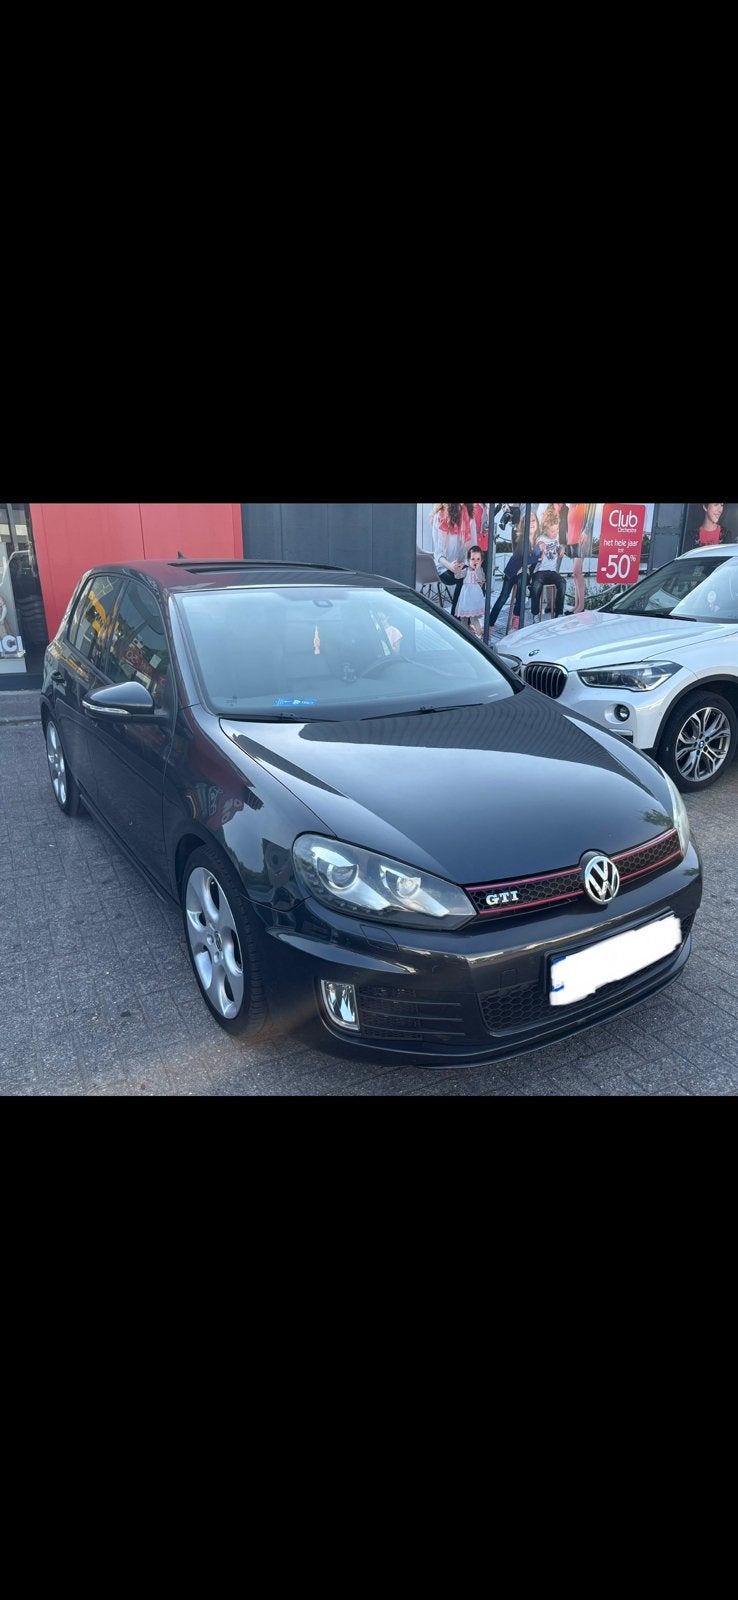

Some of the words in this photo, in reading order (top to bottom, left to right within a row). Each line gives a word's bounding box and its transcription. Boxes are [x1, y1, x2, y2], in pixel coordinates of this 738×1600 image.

[609, 510, 638, 527] Club
[627, 540, 638, 548] jaar
[601, 554, 636, 578] -50%
[486, 890, 519, 905] GTI
